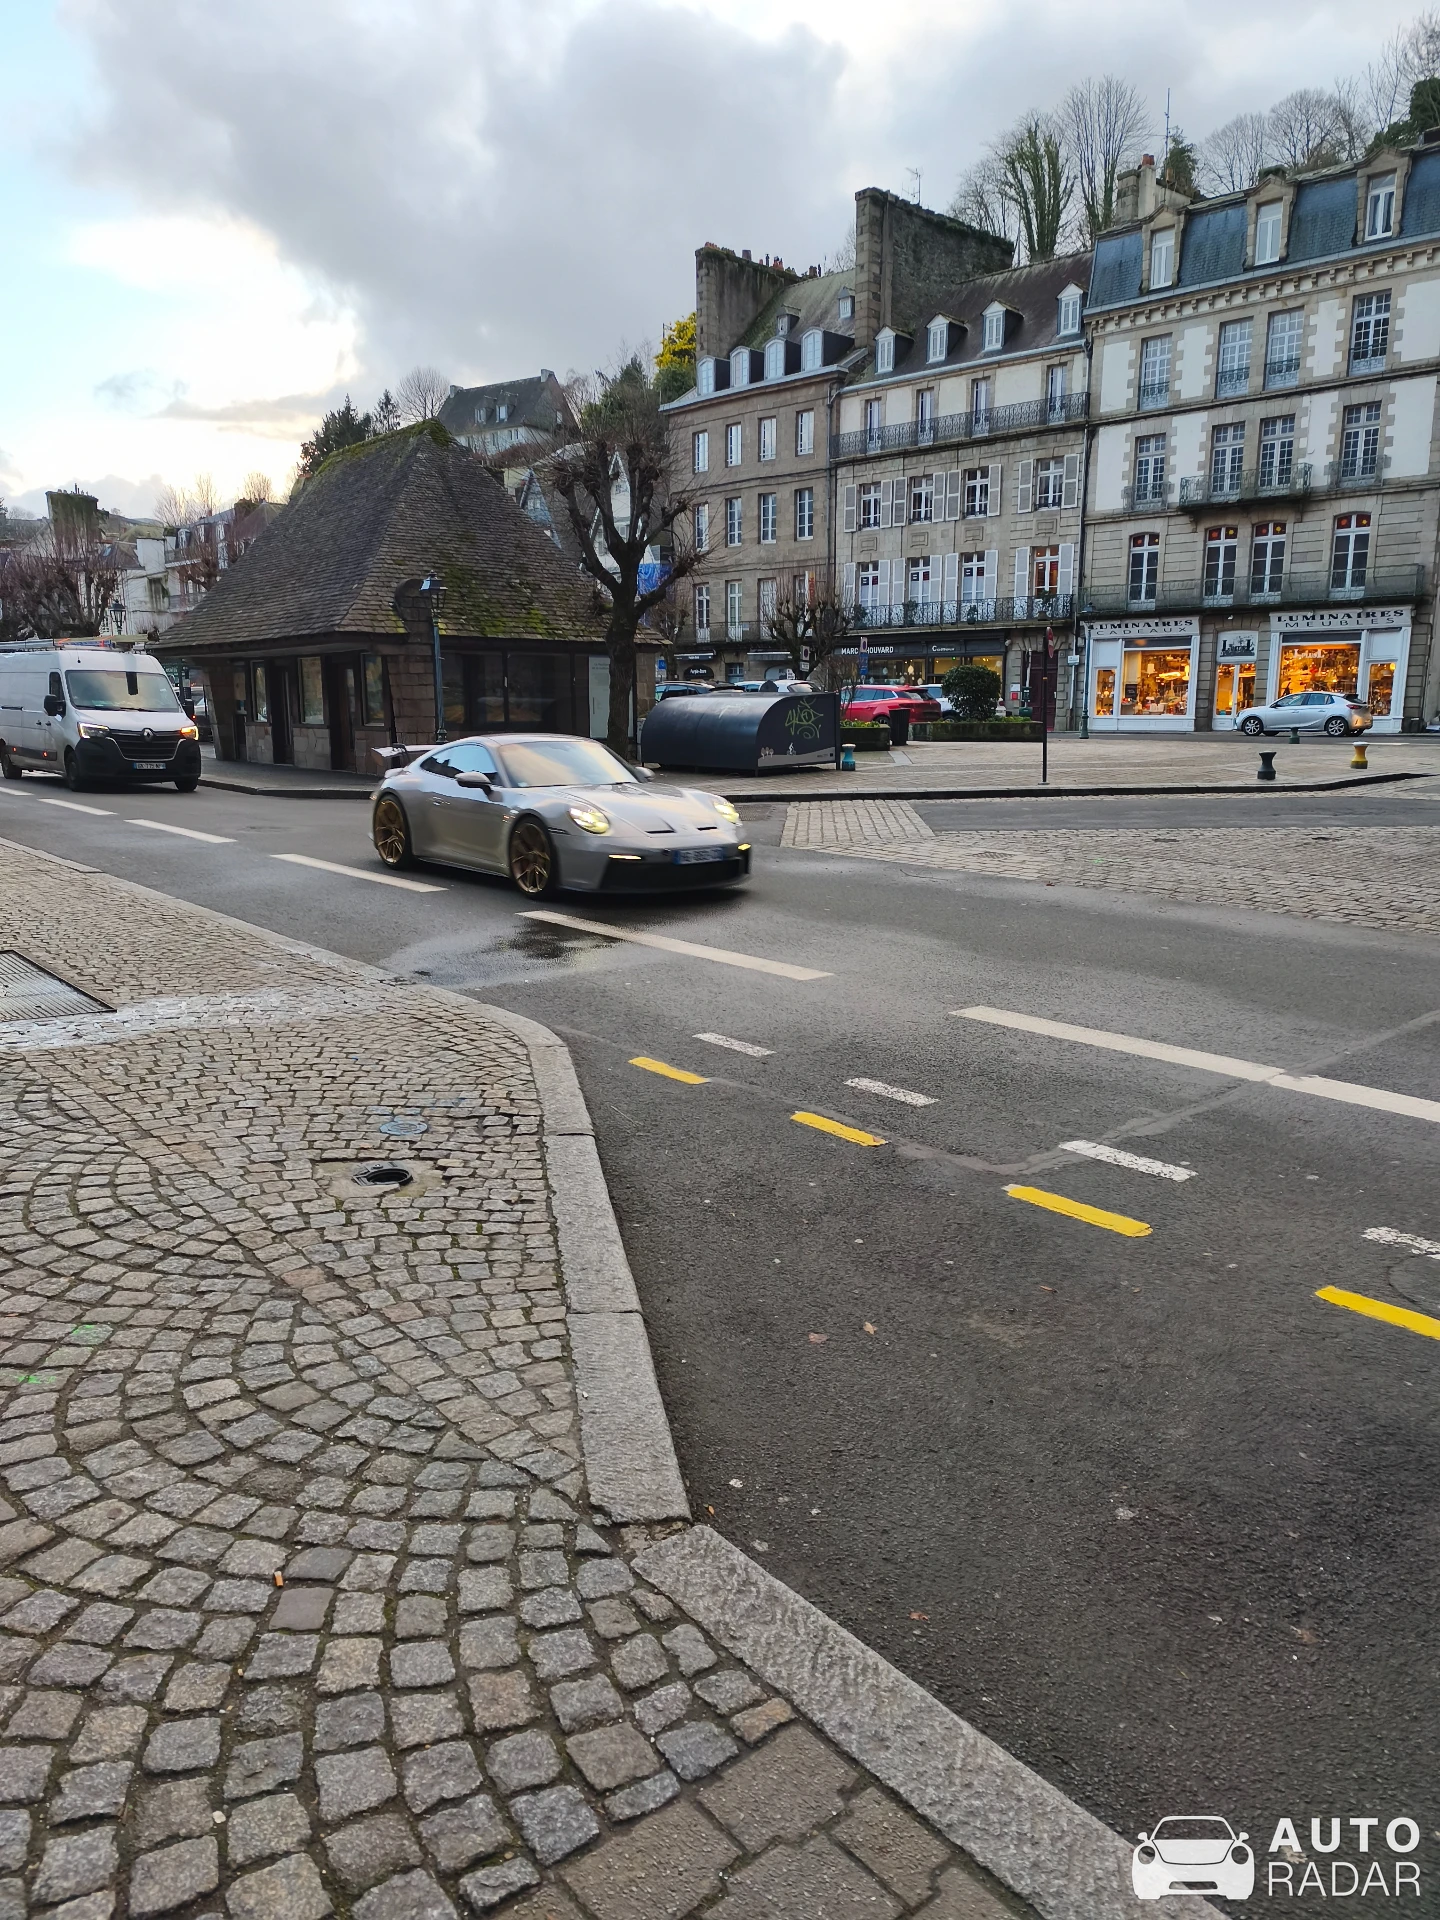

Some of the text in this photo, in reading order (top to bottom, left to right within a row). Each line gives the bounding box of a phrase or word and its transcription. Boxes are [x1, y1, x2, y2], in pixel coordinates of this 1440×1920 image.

[1277, 609, 1404, 622] LUMINAIRES
[1088, 619, 1193, 630] LUMINAIRES
[1285, 617, 1395, 628] MEUBLES
[1096, 627, 1187, 635] CADEAUX
[841, 646, 859, 655] MARC
